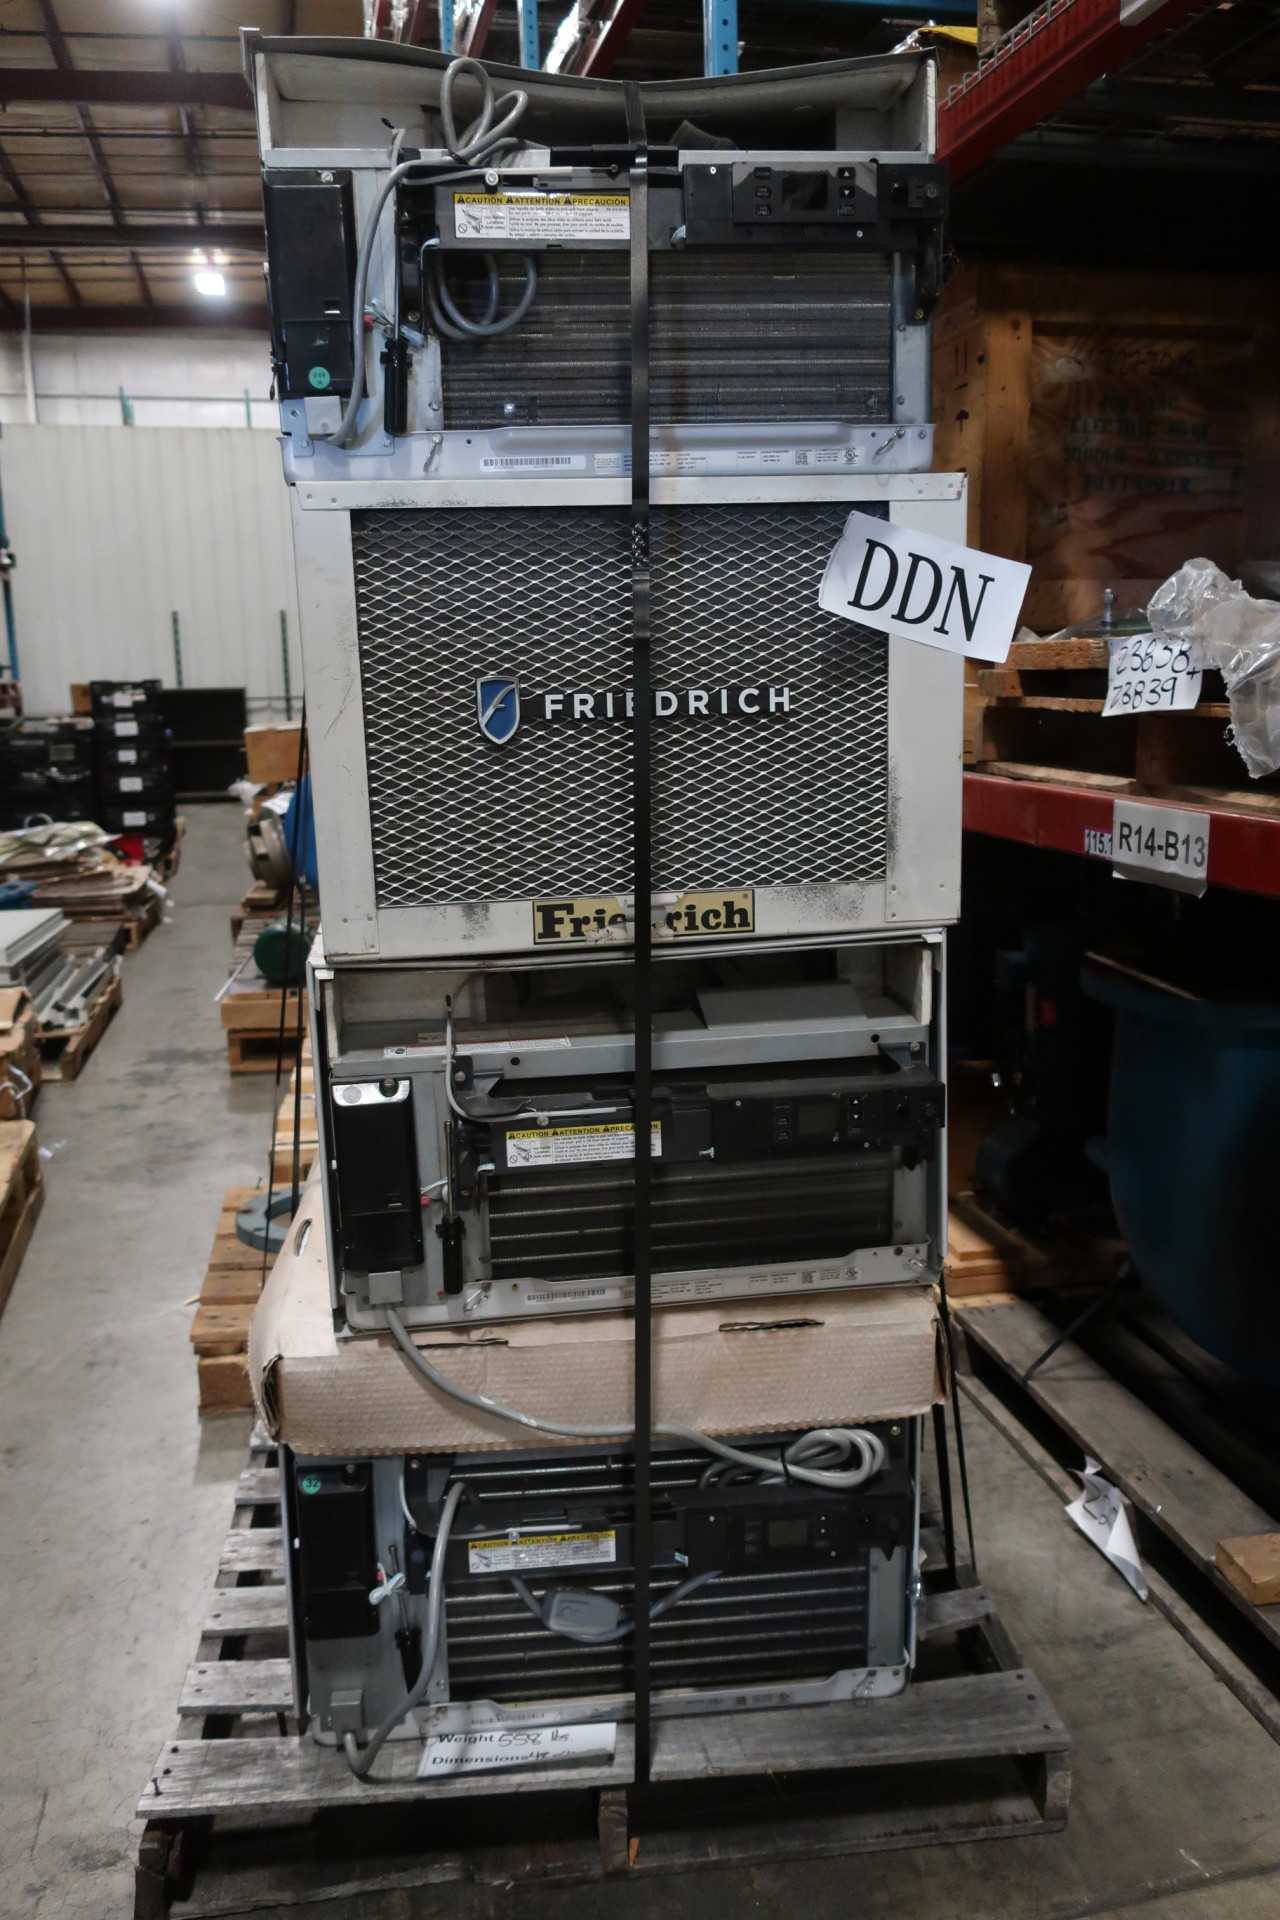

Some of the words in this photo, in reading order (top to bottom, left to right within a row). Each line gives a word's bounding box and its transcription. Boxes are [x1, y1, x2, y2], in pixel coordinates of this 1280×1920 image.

[847, 537, 995, 642] DDN
[544, 686, 790, 720] FRIEDRICH
[1118, 821, 1206, 868] R14-B13
